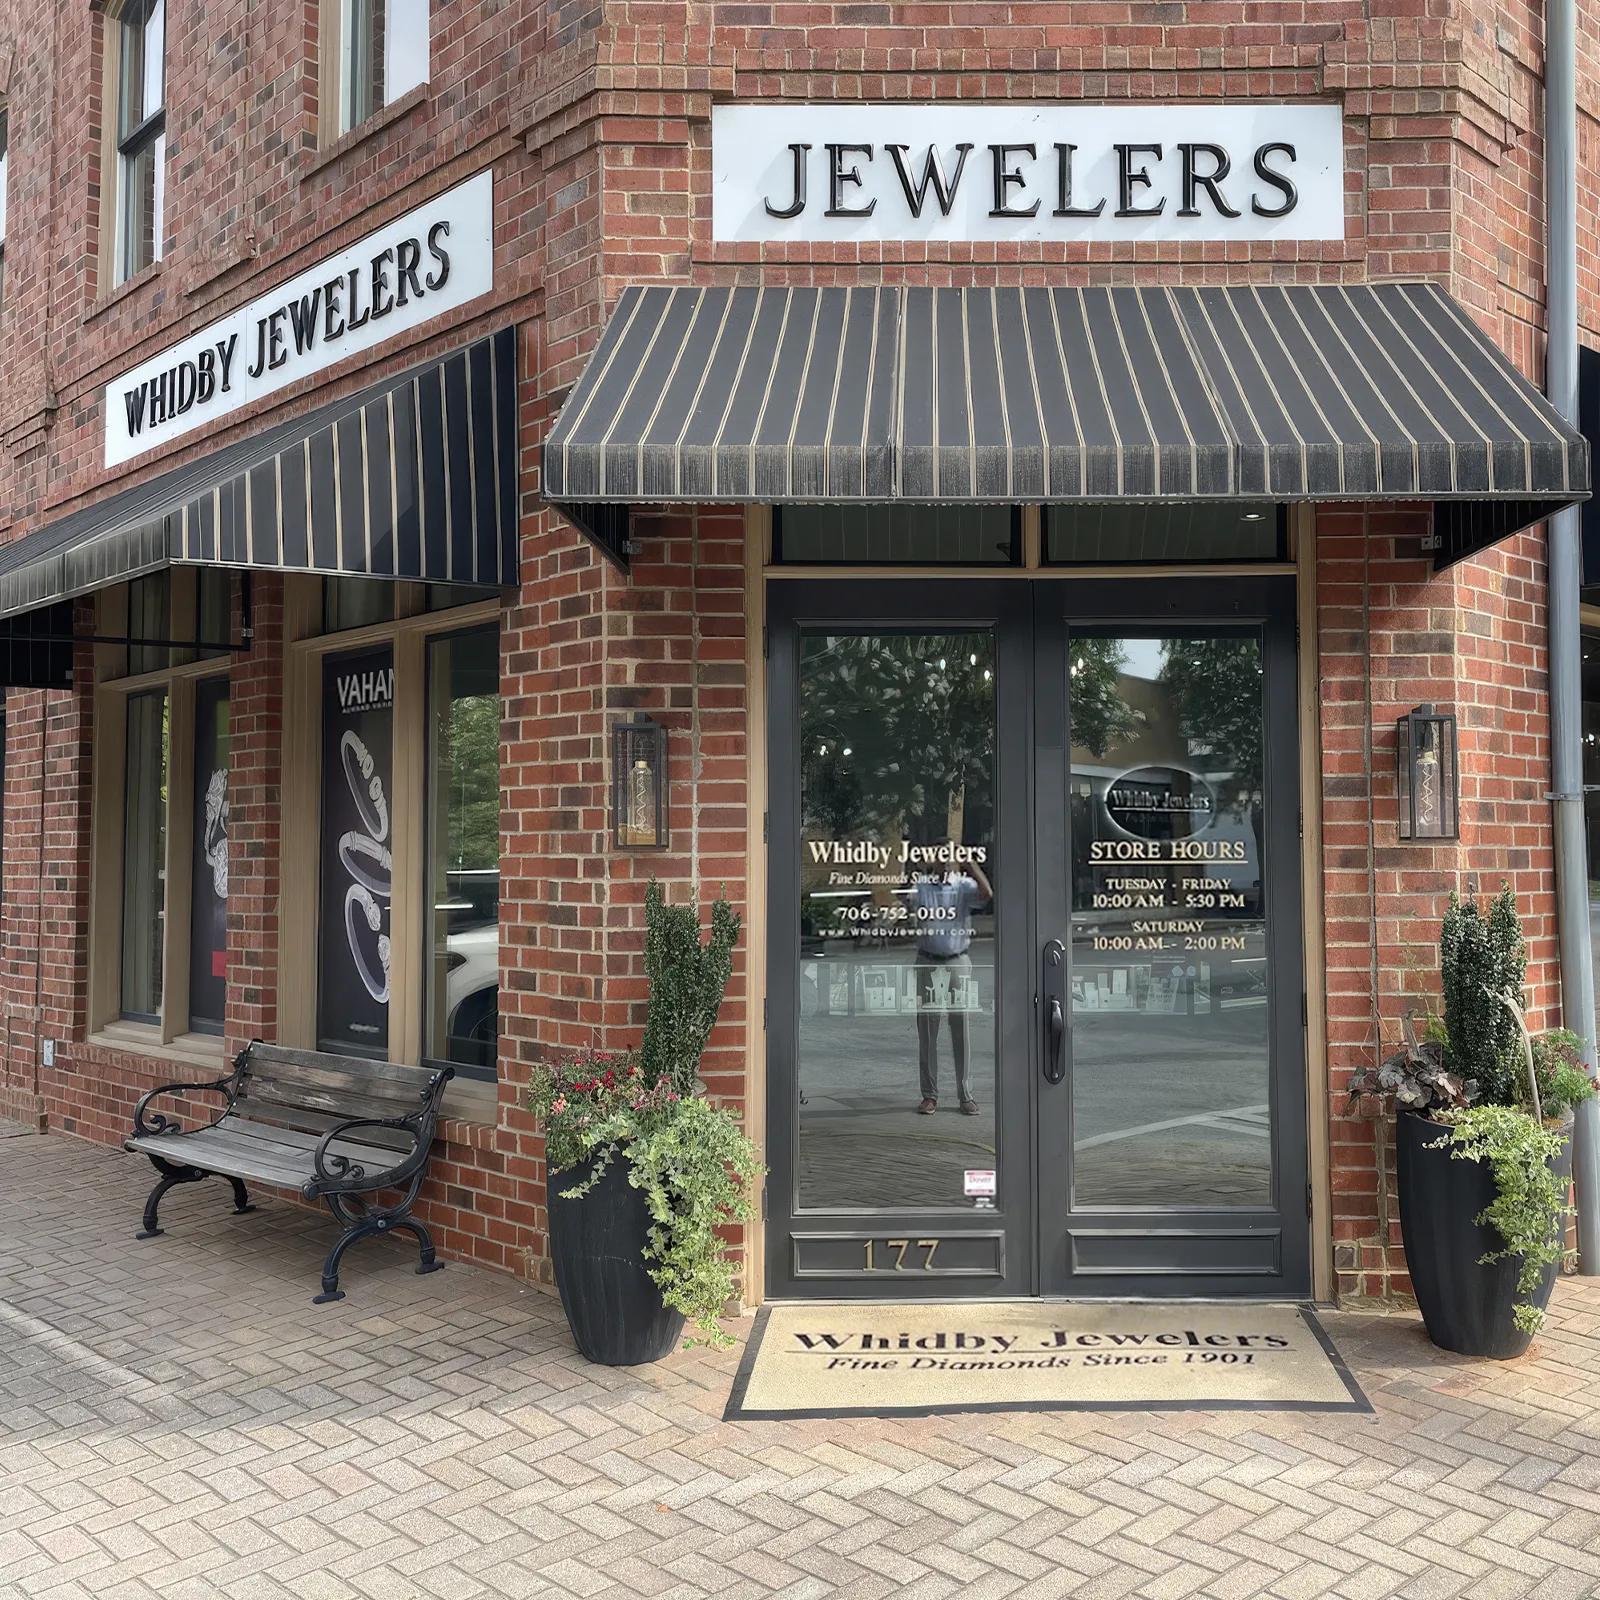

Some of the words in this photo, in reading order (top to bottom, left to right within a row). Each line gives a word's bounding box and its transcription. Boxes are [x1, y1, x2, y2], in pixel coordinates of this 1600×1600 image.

[764, 142, 1298, 219] JEWELERS
[124, 333, 239, 438] WHIDBY
[248, 221, 450, 379] JEWELERS
[808, 840, 892, 868] Whidby
[897, 840, 987, 863] Jewelers
[1091, 841, 1161, 859] STORE
[1170, 841, 1245, 859] HOURS
[828, 871, 853, 884] Fine
[855, 871, 909, 884] Diamonds
[910, 871, 939, 884] Since
[1106, 878, 1167, 890] TUESDAY
[1182, 878, 1231, 890] FRIDAY
[1093, 894, 1132, 908] 10:00
[1134, 894, 1164, 908] AM
[1185, 894, 1215, 908] 5:30
[1219, 894, 1245, 908] PM
[839, 907, 957, 920] 706-752-0105
[1133, 921, 1205, 932] SATURDAY
[1093, 937, 1132, 950] 10:00
[1134, 937, 1164, 950] AM
[1184, 937, 1217, 950] 2:00
[1221, 937, 1245, 950] PM
[863, 1239, 939, 1271] 177
[794, 1332, 1019, 1354] Whidby
[1041, 1330, 1290, 1348] Jewelers
[825, 1357, 899, 1370] Fine
[909, 1355, 1072, 1370] Diamonds
[1083, 1353, 1168, 1367] Since
[1183, 1352, 1256, 1365] 1901
